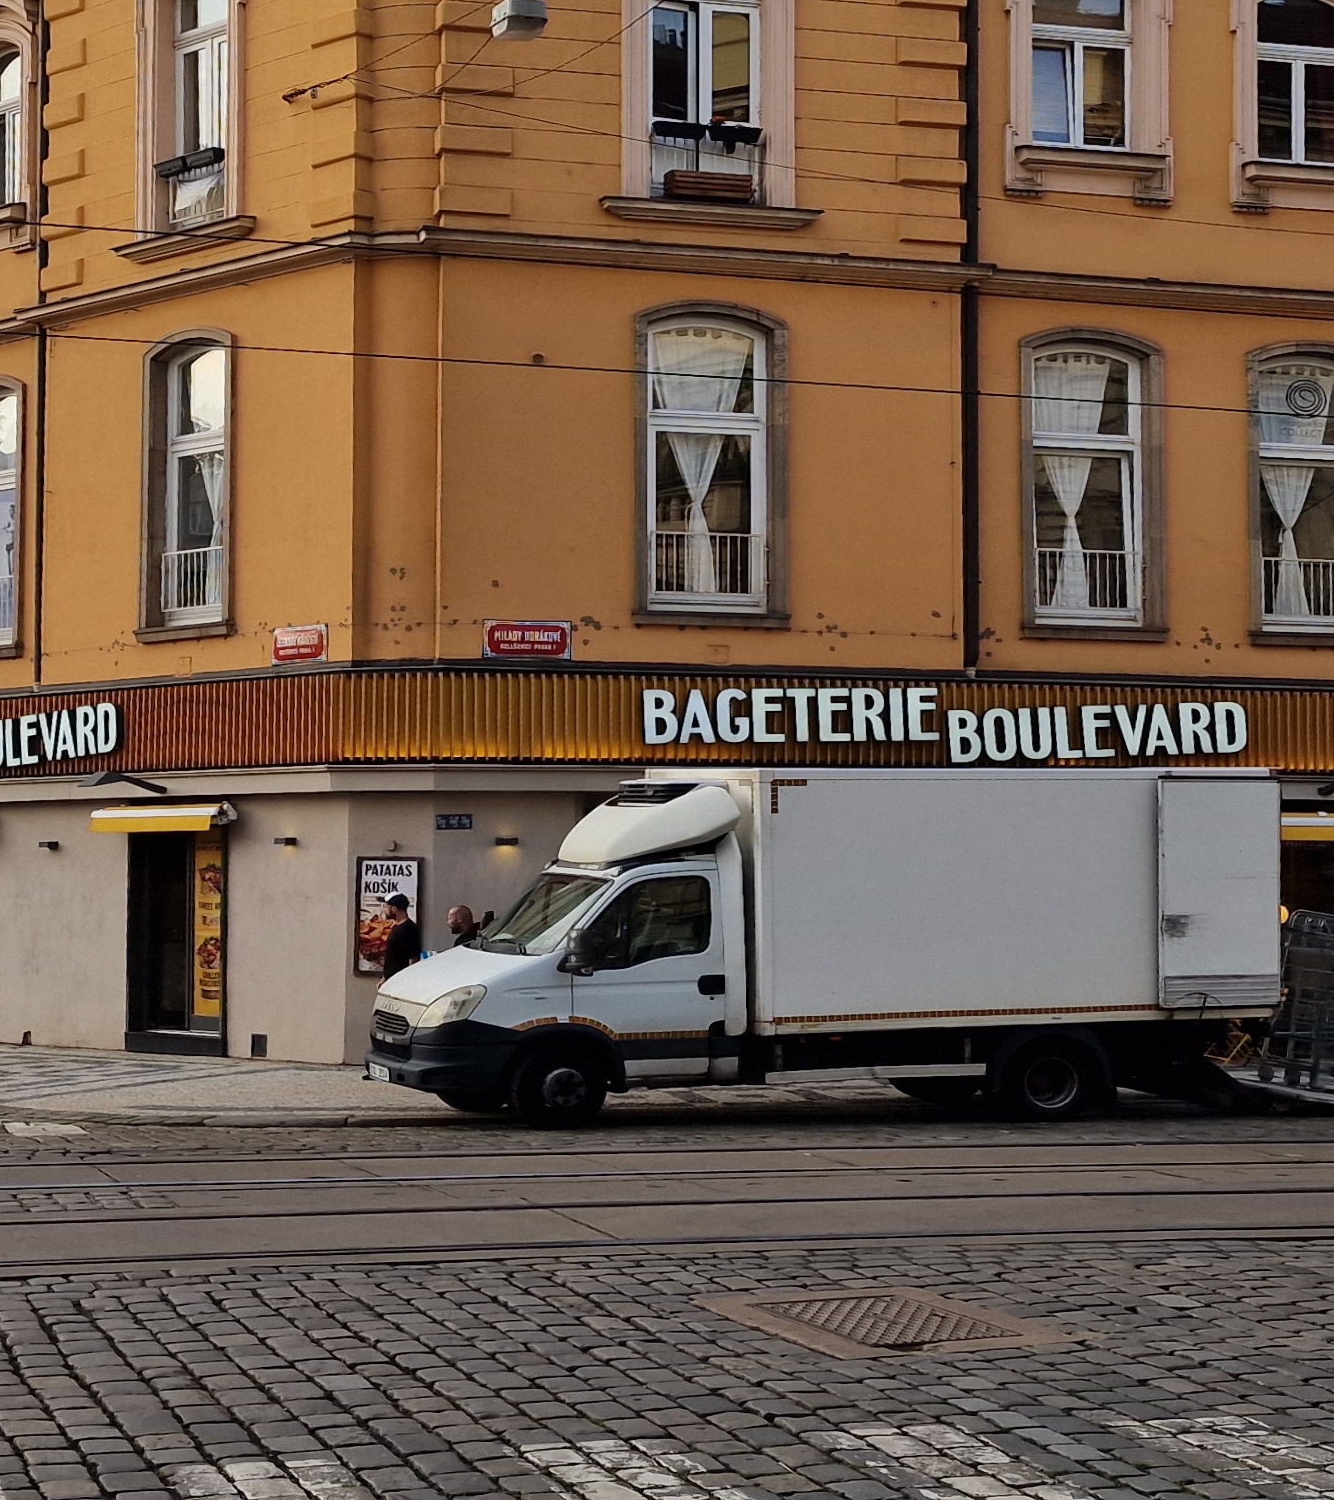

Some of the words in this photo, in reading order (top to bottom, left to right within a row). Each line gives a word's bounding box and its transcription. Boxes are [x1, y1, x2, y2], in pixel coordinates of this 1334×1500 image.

[494, 630, 523, 642] MILADY
[643, 687, 940, 744] BAGETERIE
[947, 701, 1248, 764] BOULEVARD
[364, 863, 413, 877] PATATAS
[364, 878, 399, 894] KOŠÍK
